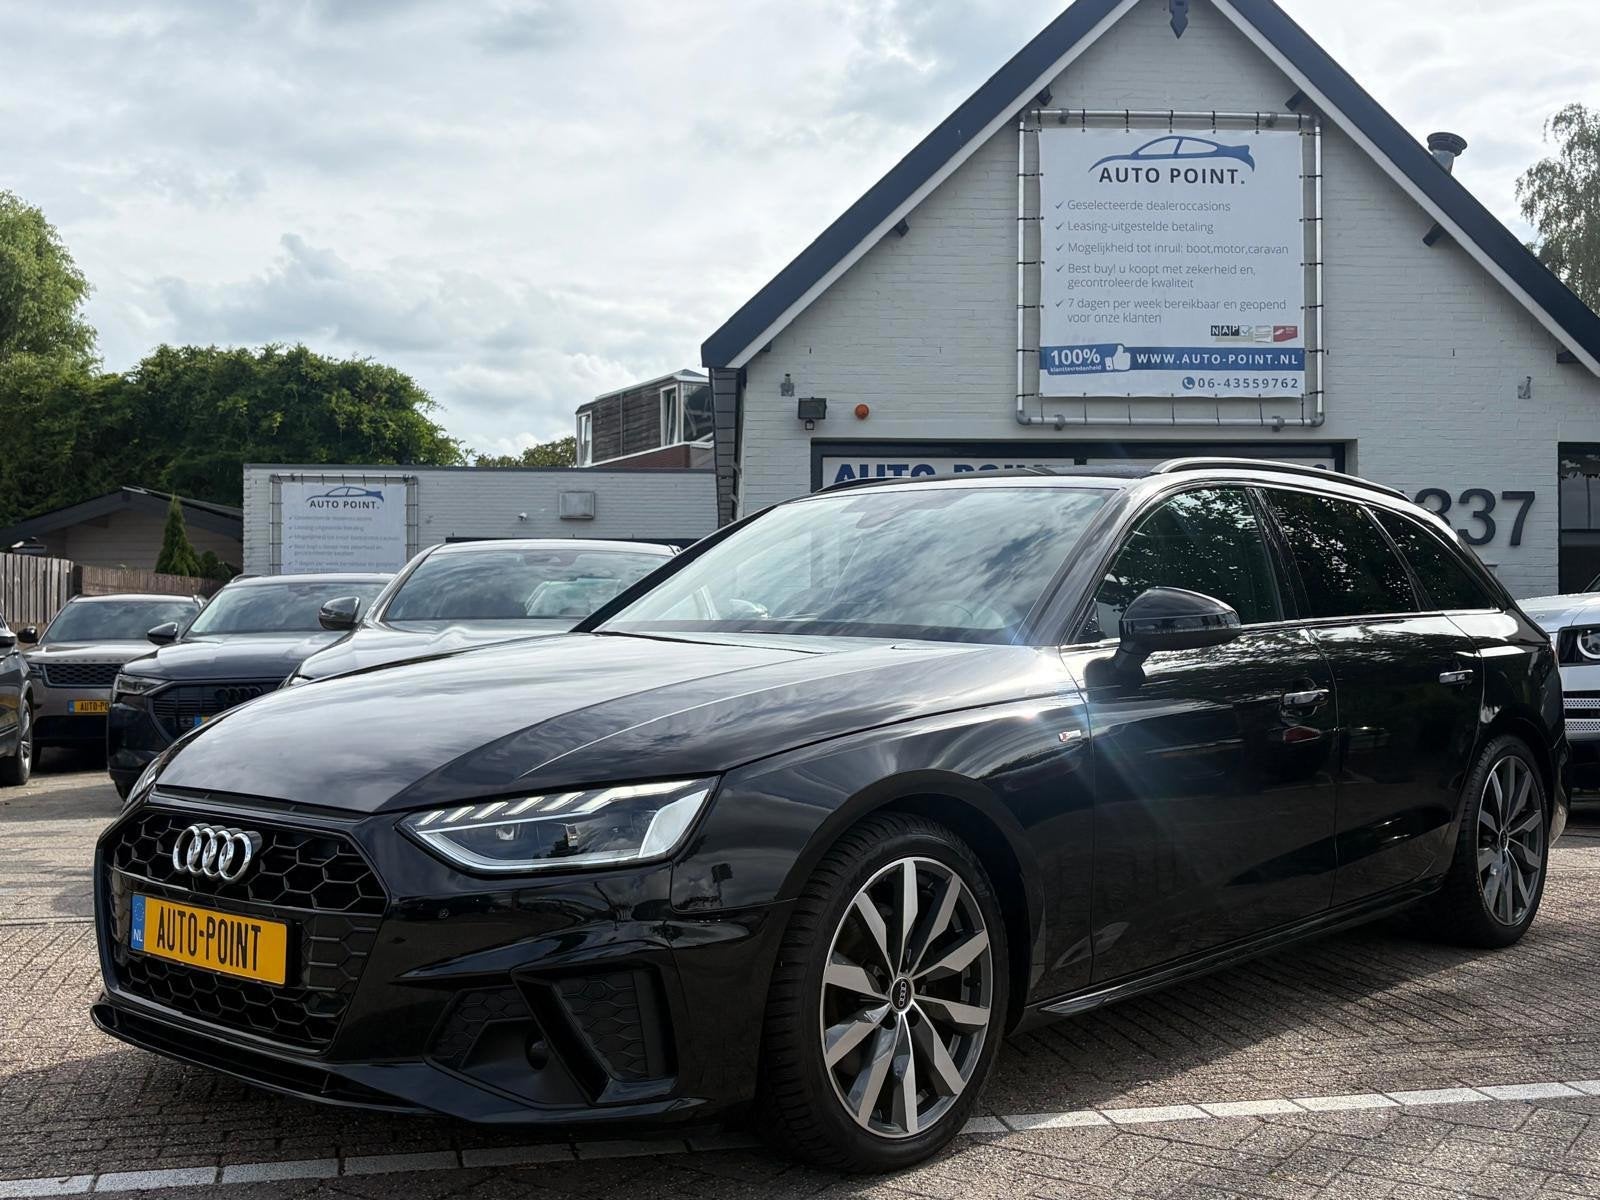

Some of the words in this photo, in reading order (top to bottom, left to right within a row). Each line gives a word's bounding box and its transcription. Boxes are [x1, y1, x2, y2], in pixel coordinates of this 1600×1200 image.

[1098, 167, 1160, 184] AUTO
[1170, 168, 1246, 185] POINT.
[1067, 200, 1143, 211] Geselecteerde
[1146, 200, 1231, 212] dealeroccasions
[1067, 221, 1169, 234] Leasing-uitgestelde
[1171, 221, 1214, 235] betaling
[1068, 243, 1134, 255] Mogelijkheid
[1136, 244, 1152, 253] tot
[1068, 264, 1092, 274] Best
[1119, 266, 1126, 274] u
[1128, 263, 1160, 277] koopt
[1162, 265, 1183, 275] met
[1185, 264, 1238, 275] zekerheid
[1067, 278, 1149, 290] gecontroleerde
[1151, 278, 1195, 289] kwaliteit
[1068, 298, 1075, 308] 7
[1077, 298, 1110, 311] dagen
[1113, 300, 1132, 310] per
[1133, 299, 1161, 309] week
[1164, 299, 1221, 310] bereikbaar
[1223, 301, 1237, 310] en
[1239, 300, 1287, 312] geopend
[1067, 314, 1092, 323] voor
[1094, 314, 1120, 323] onze
[1122, 312, 1162, 323] klanten
[1050, 348, 1101, 366] 100%
[1136, 353, 1299, 365] WWW.AUTO-POINT.NL
[1197, 377, 1299, 389] 06-43559762
[309, 500, 339, 509] AUTO
[133, 928, 143, 942] NL
[156, 906, 262, 971] AUTO-POINT
